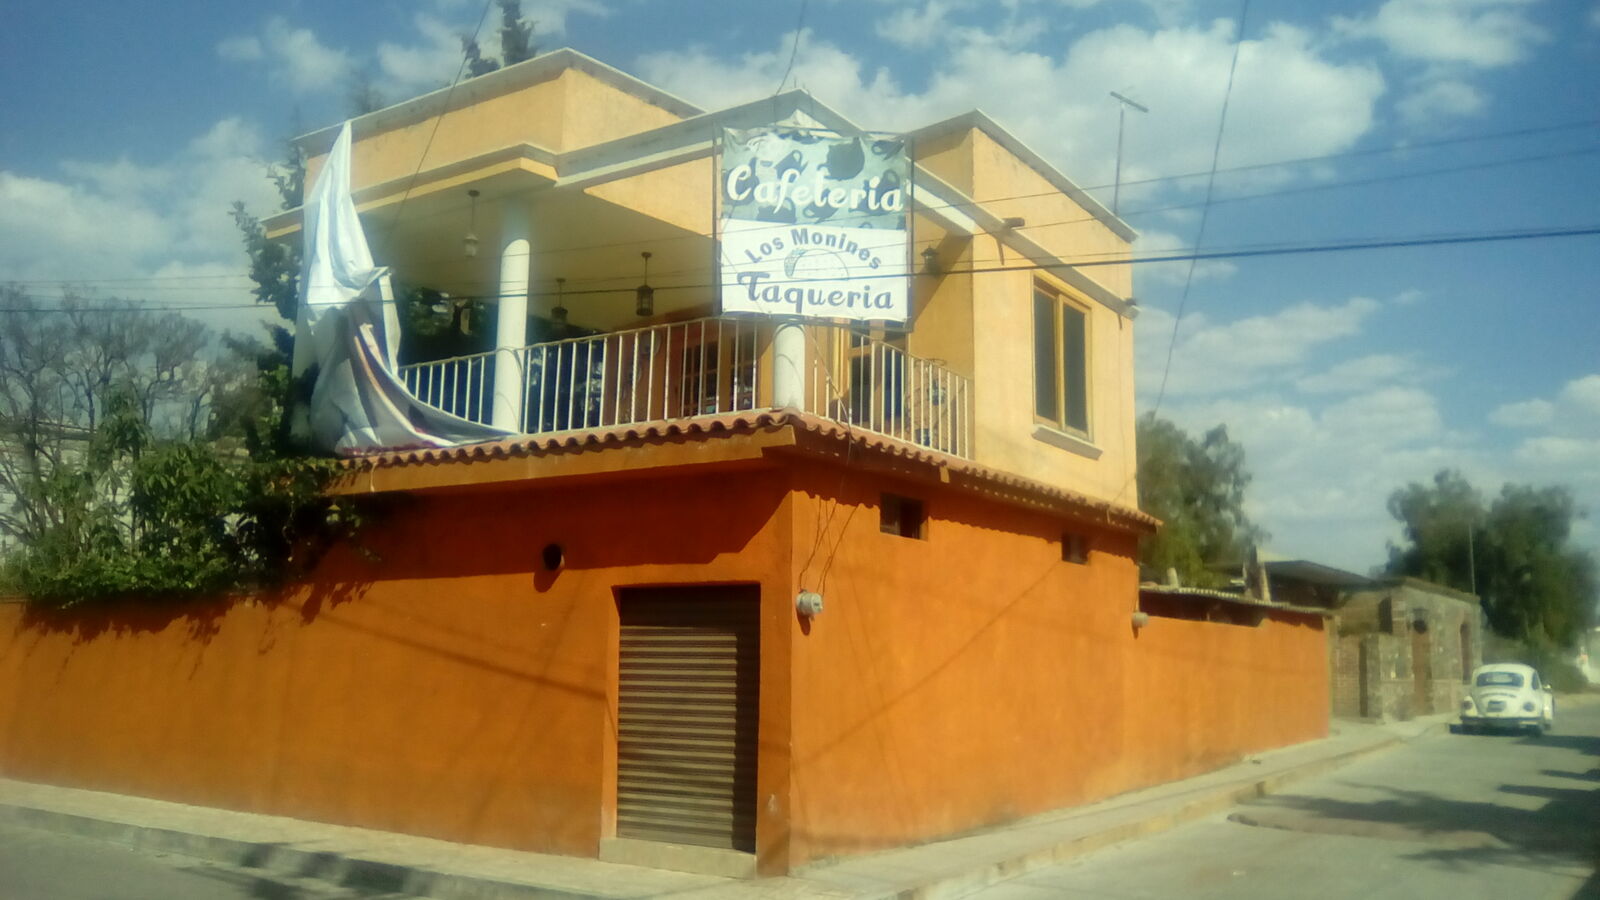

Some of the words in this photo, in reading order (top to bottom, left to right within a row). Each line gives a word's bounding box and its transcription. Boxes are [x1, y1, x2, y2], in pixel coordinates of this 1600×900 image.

[744, 237, 784, 264] Los
[790, 228, 882, 270] Monines
[737, 271, 894, 313] Taqueria
